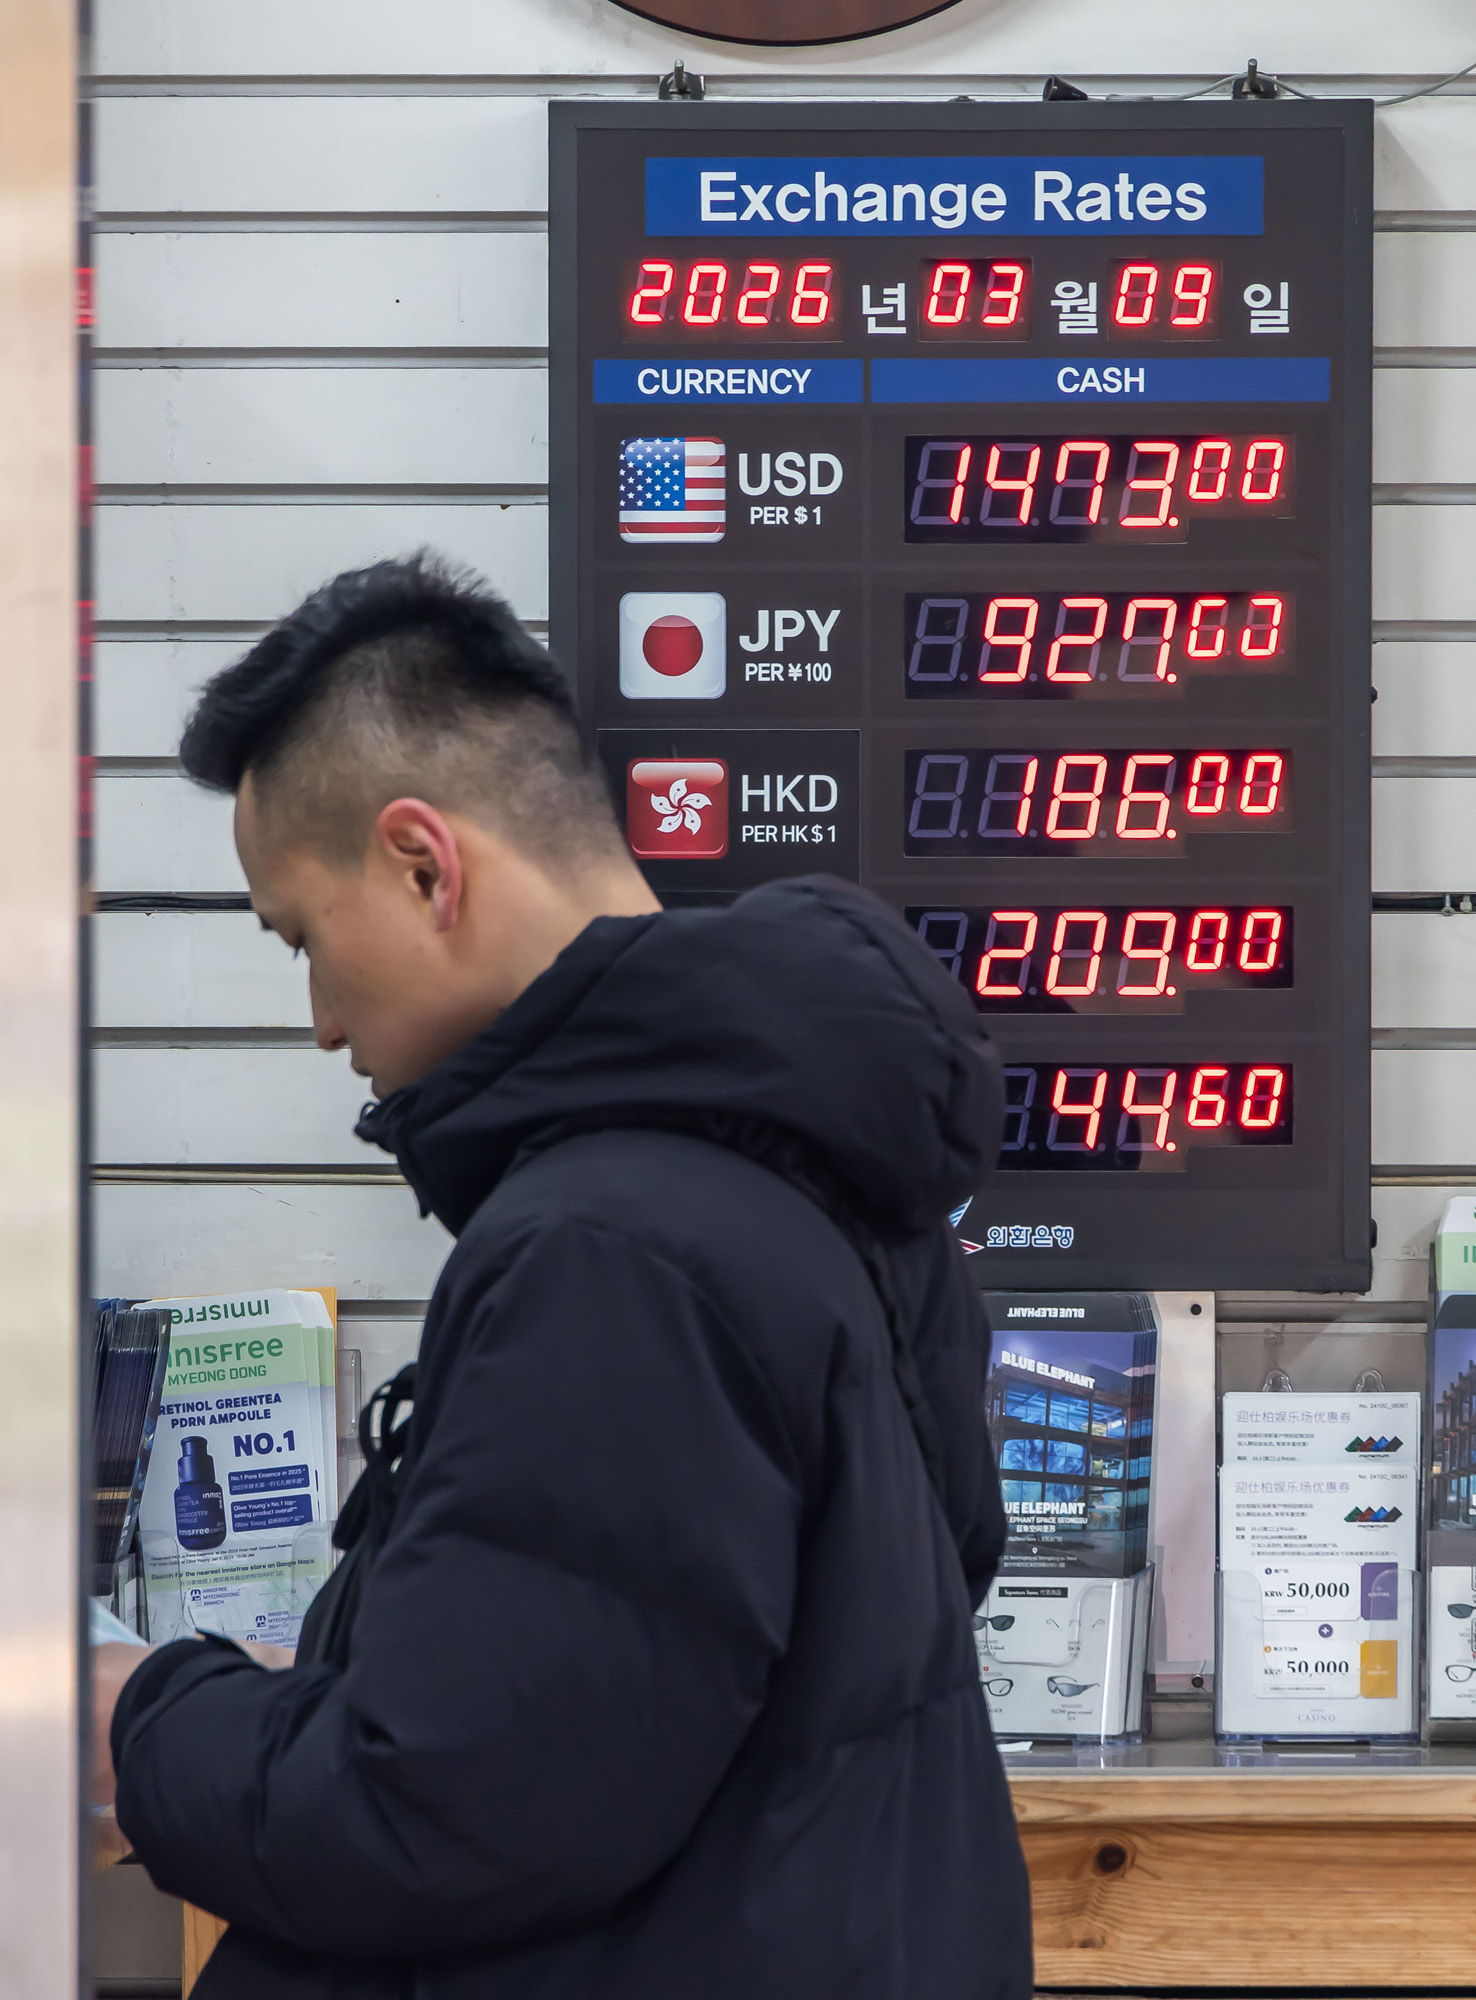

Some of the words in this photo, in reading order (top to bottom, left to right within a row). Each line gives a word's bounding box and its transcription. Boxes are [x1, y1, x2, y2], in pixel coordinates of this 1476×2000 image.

[699, 170, 1007, 229] Exchange
[1033, 170, 1208, 223] Rates
[628, 262, 833, 325] 2026
[862, 283, 907, 335] 년
[926, 262, 1028, 325] 03
[1051, 280, 1099, 335] 월
[1113, 264, 1214, 326] 09
[1243, 281, 1290, 335] 일
[637, 368, 812, 395] CURRENCY
[1057, 367, 1145, 393] CASH
[738, 451, 844, 497] USD
[750, 506, 789, 525] PER
[739, 609, 842, 652] JPY
[745, 662, 784, 682] PER
[741, 774, 839, 813] HKD
[742, 825, 778, 843] PER
[987, 1225, 1074, 1249] 외환은행
[1007, 1307, 1059, 1318] ELEPHANT
[1059, 1308, 1086, 1319] BLUE
[168, 1369, 226, 1386] MYEONG
[229, 1364, 267, 1380] DONG
[1001, 1350, 1036, 1373] BLUE
[1036, 1361, 1096, 1389] ELEPHANT
[159, 1400, 214, 1416] RETINOL
[215, 1393, 282, 1410] GREENTEA
[171, 1415, 206, 1429] PDRN
[209, 1408, 272, 1425] AMPOULE
[233, 1430, 296, 1458] NO.1
[234, 1511, 252, 1519] selling
[252, 1510, 274, 1518] product
[1003, 1501, 1021, 1514] UE
[1021, 1501, 1086, 1515] ELEPHANT
[1036, 1516, 1057, 1524] SPACE
[1287, 1582, 1350, 1600] 50,000
[1287, 1660, 1349, 1677] 50,000
[1297, 1714, 1336, 1722] CASINO
